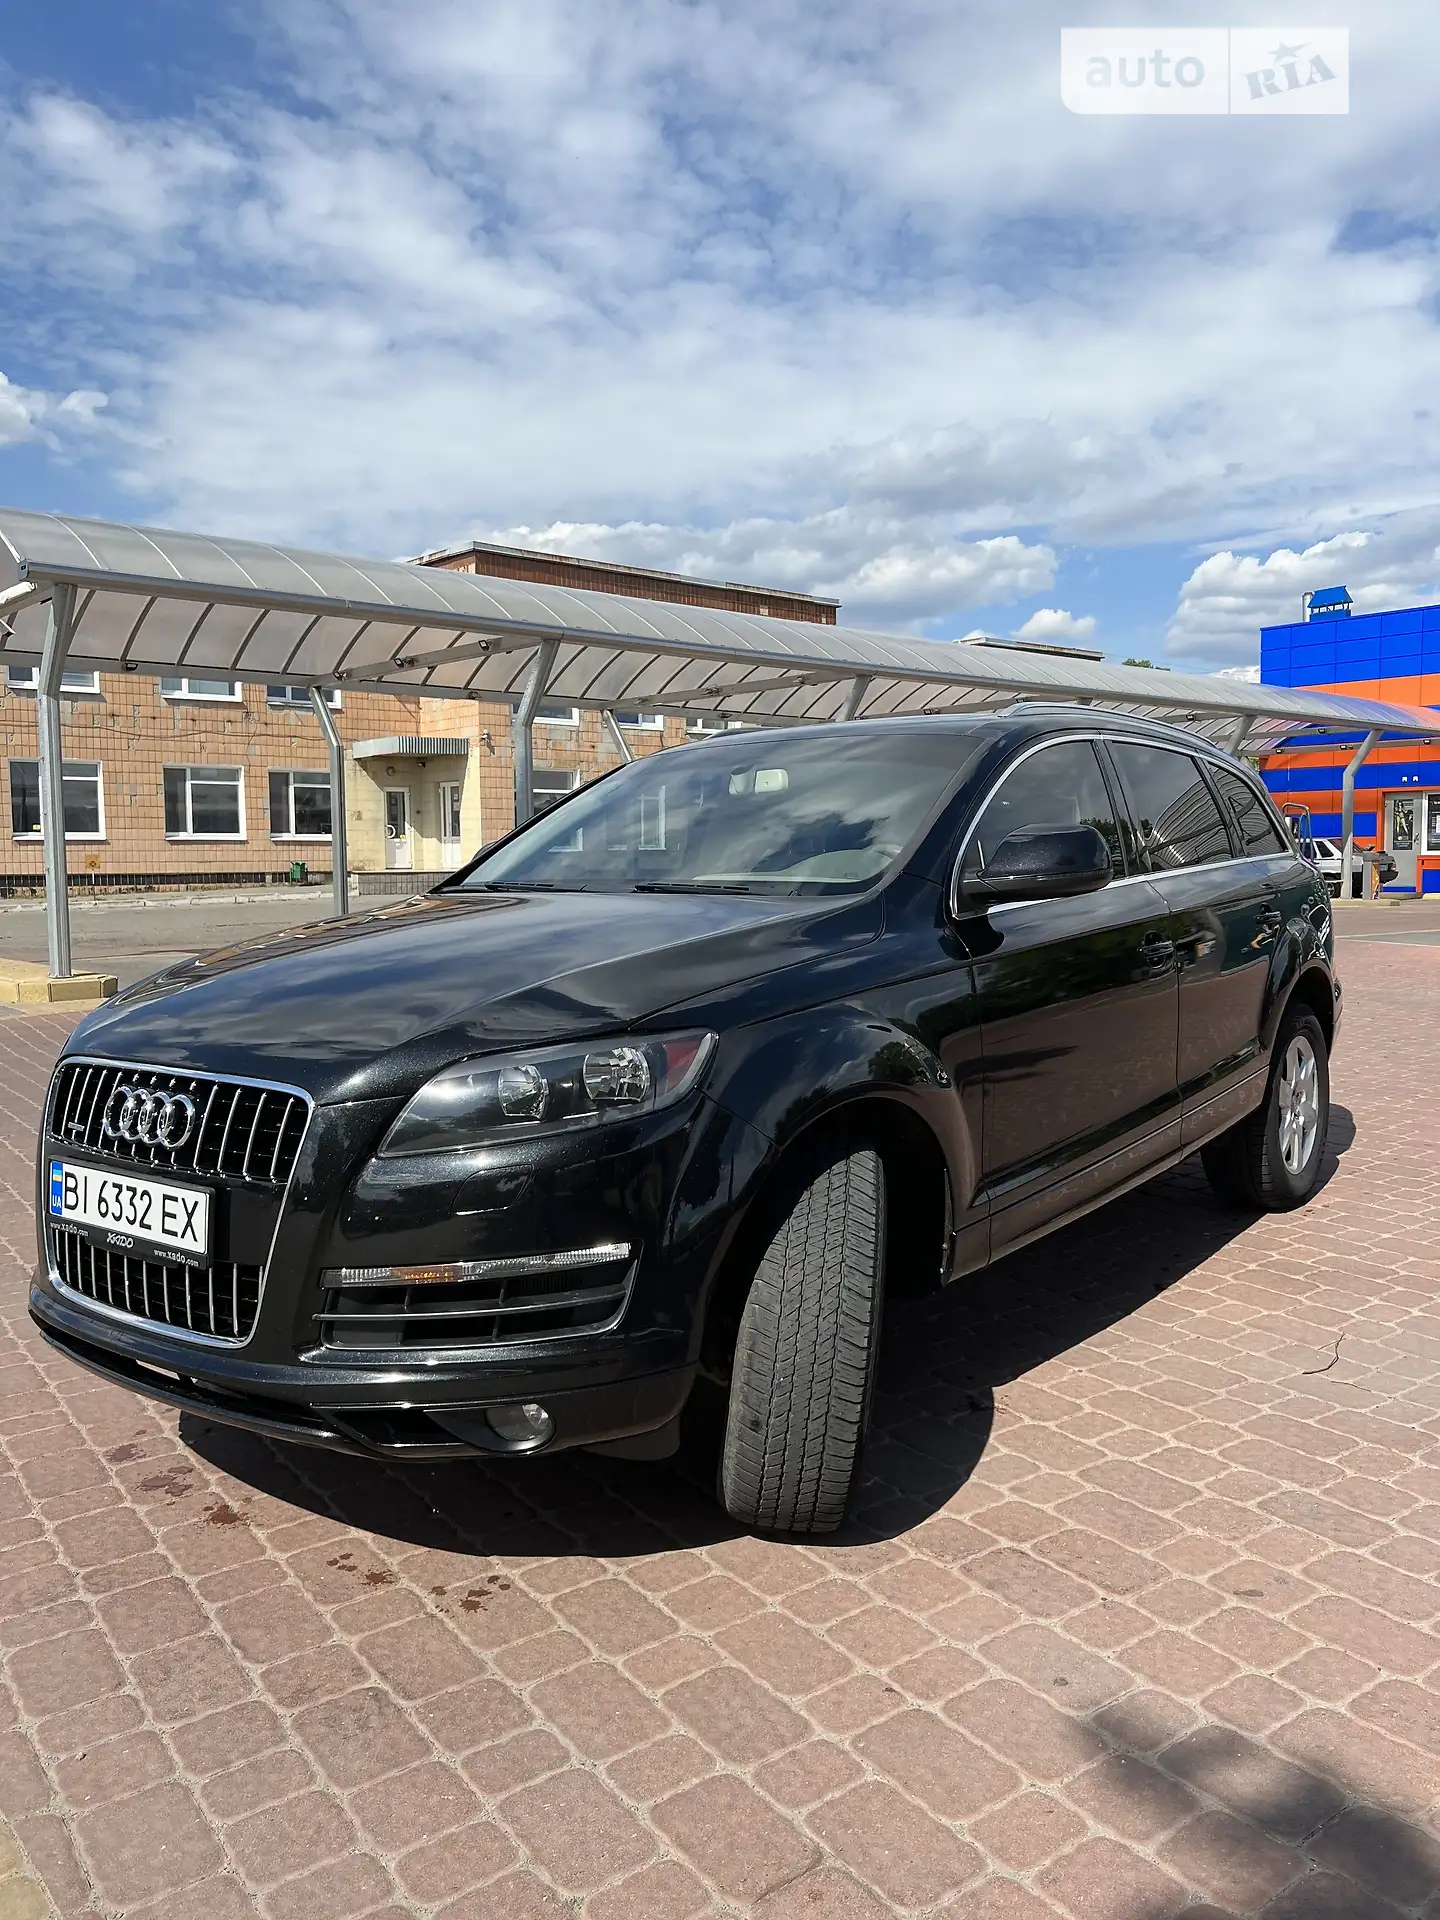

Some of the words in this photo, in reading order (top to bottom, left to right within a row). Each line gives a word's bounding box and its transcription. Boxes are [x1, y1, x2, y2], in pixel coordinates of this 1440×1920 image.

[52, 1195, 62, 1208] UA
[64, 1171, 88, 1214] BI
[97, 1180, 153, 1231] 6332
[161, 1193, 199, 1243] EX
[50, 1222, 89, 1237] www.xado.com
[106, 1232, 134, 1248] XADO
[153, 1249, 199, 1268] www.xado.com
